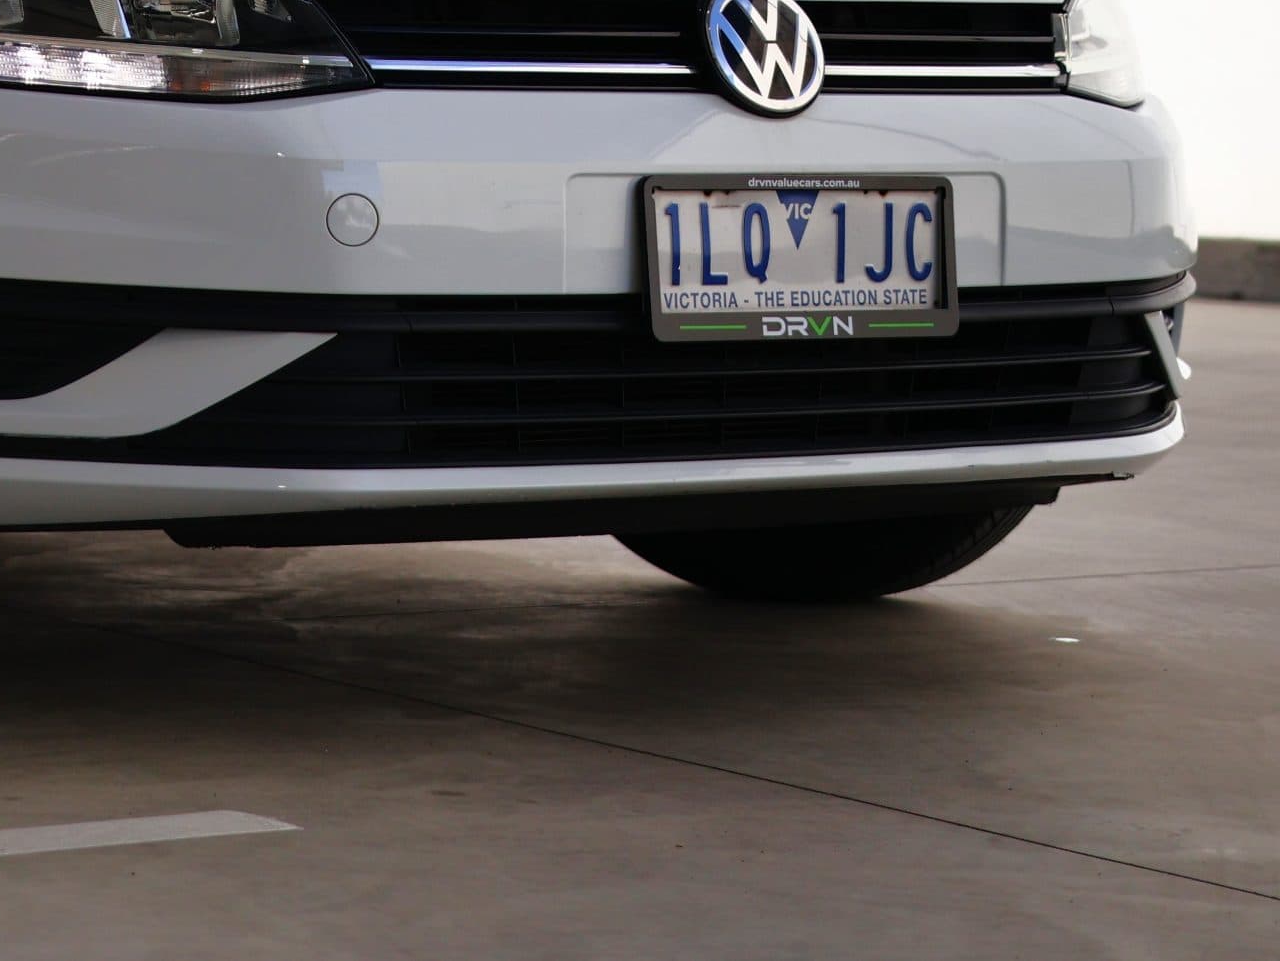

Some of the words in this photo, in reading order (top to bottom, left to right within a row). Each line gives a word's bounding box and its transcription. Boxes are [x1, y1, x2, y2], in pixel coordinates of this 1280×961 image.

[748, 177, 860, 189] drvnvaluecars.com.au
[784, 202, 813, 220] VIC
[665, 202, 771, 287] 1LQ
[832, 202, 933, 283] 1JC
[663, 291, 738, 310] VICTORIA
[755, 290, 785, 308] THE
[790, 289, 878, 307] EDUCATION
[883, 288, 928, 305] STATE
[761, 315, 854, 336] DRVN
